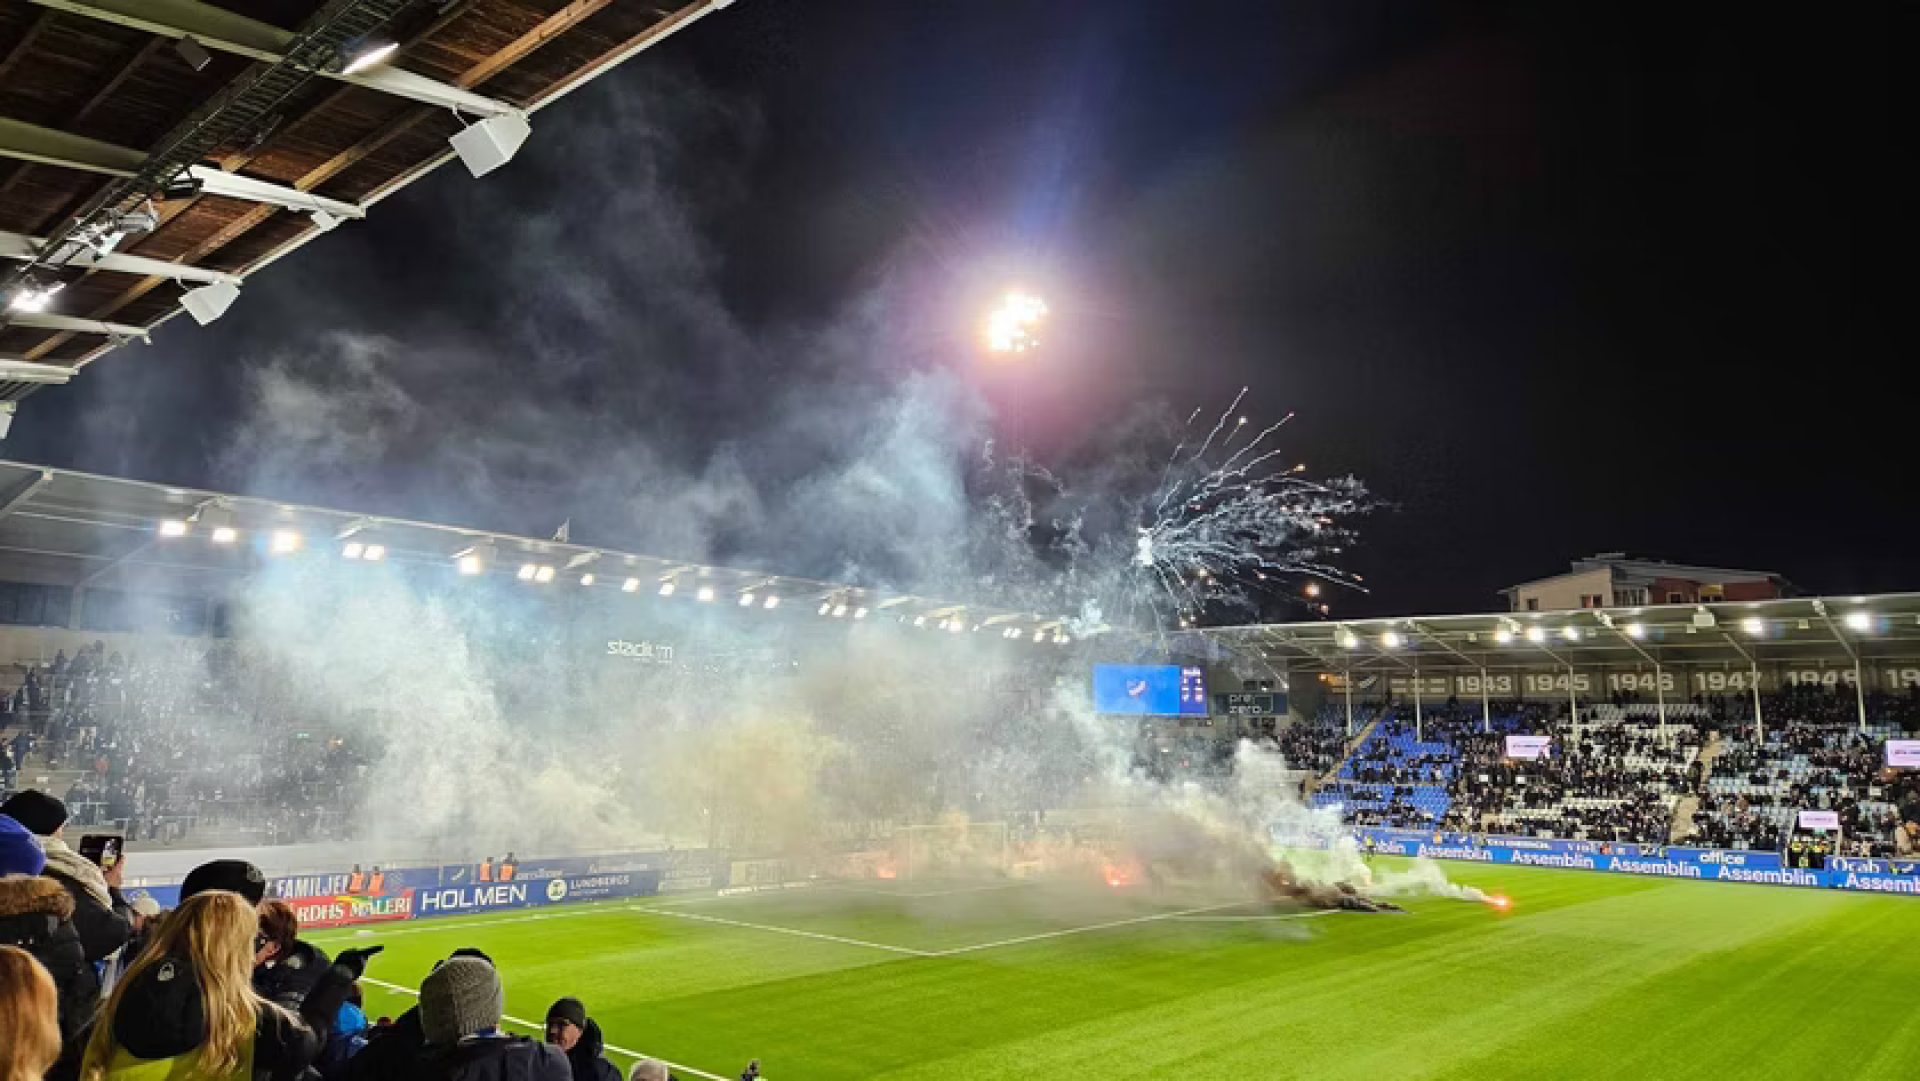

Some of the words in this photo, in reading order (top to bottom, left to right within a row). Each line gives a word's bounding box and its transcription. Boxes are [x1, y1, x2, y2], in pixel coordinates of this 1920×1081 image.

[1456, 676, 1511, 693] 1943
[1526, 674, 1589, 692] 1945
[1417, 843, 1493, 861] Assemblin
[1510, 849, 1594, 869] Assemblin
[1609, 856, 1701, 878] Assemblin
[1718, 863, 1818, 886] Assemblin
[422, 884, 527, 911] HOLMEN
